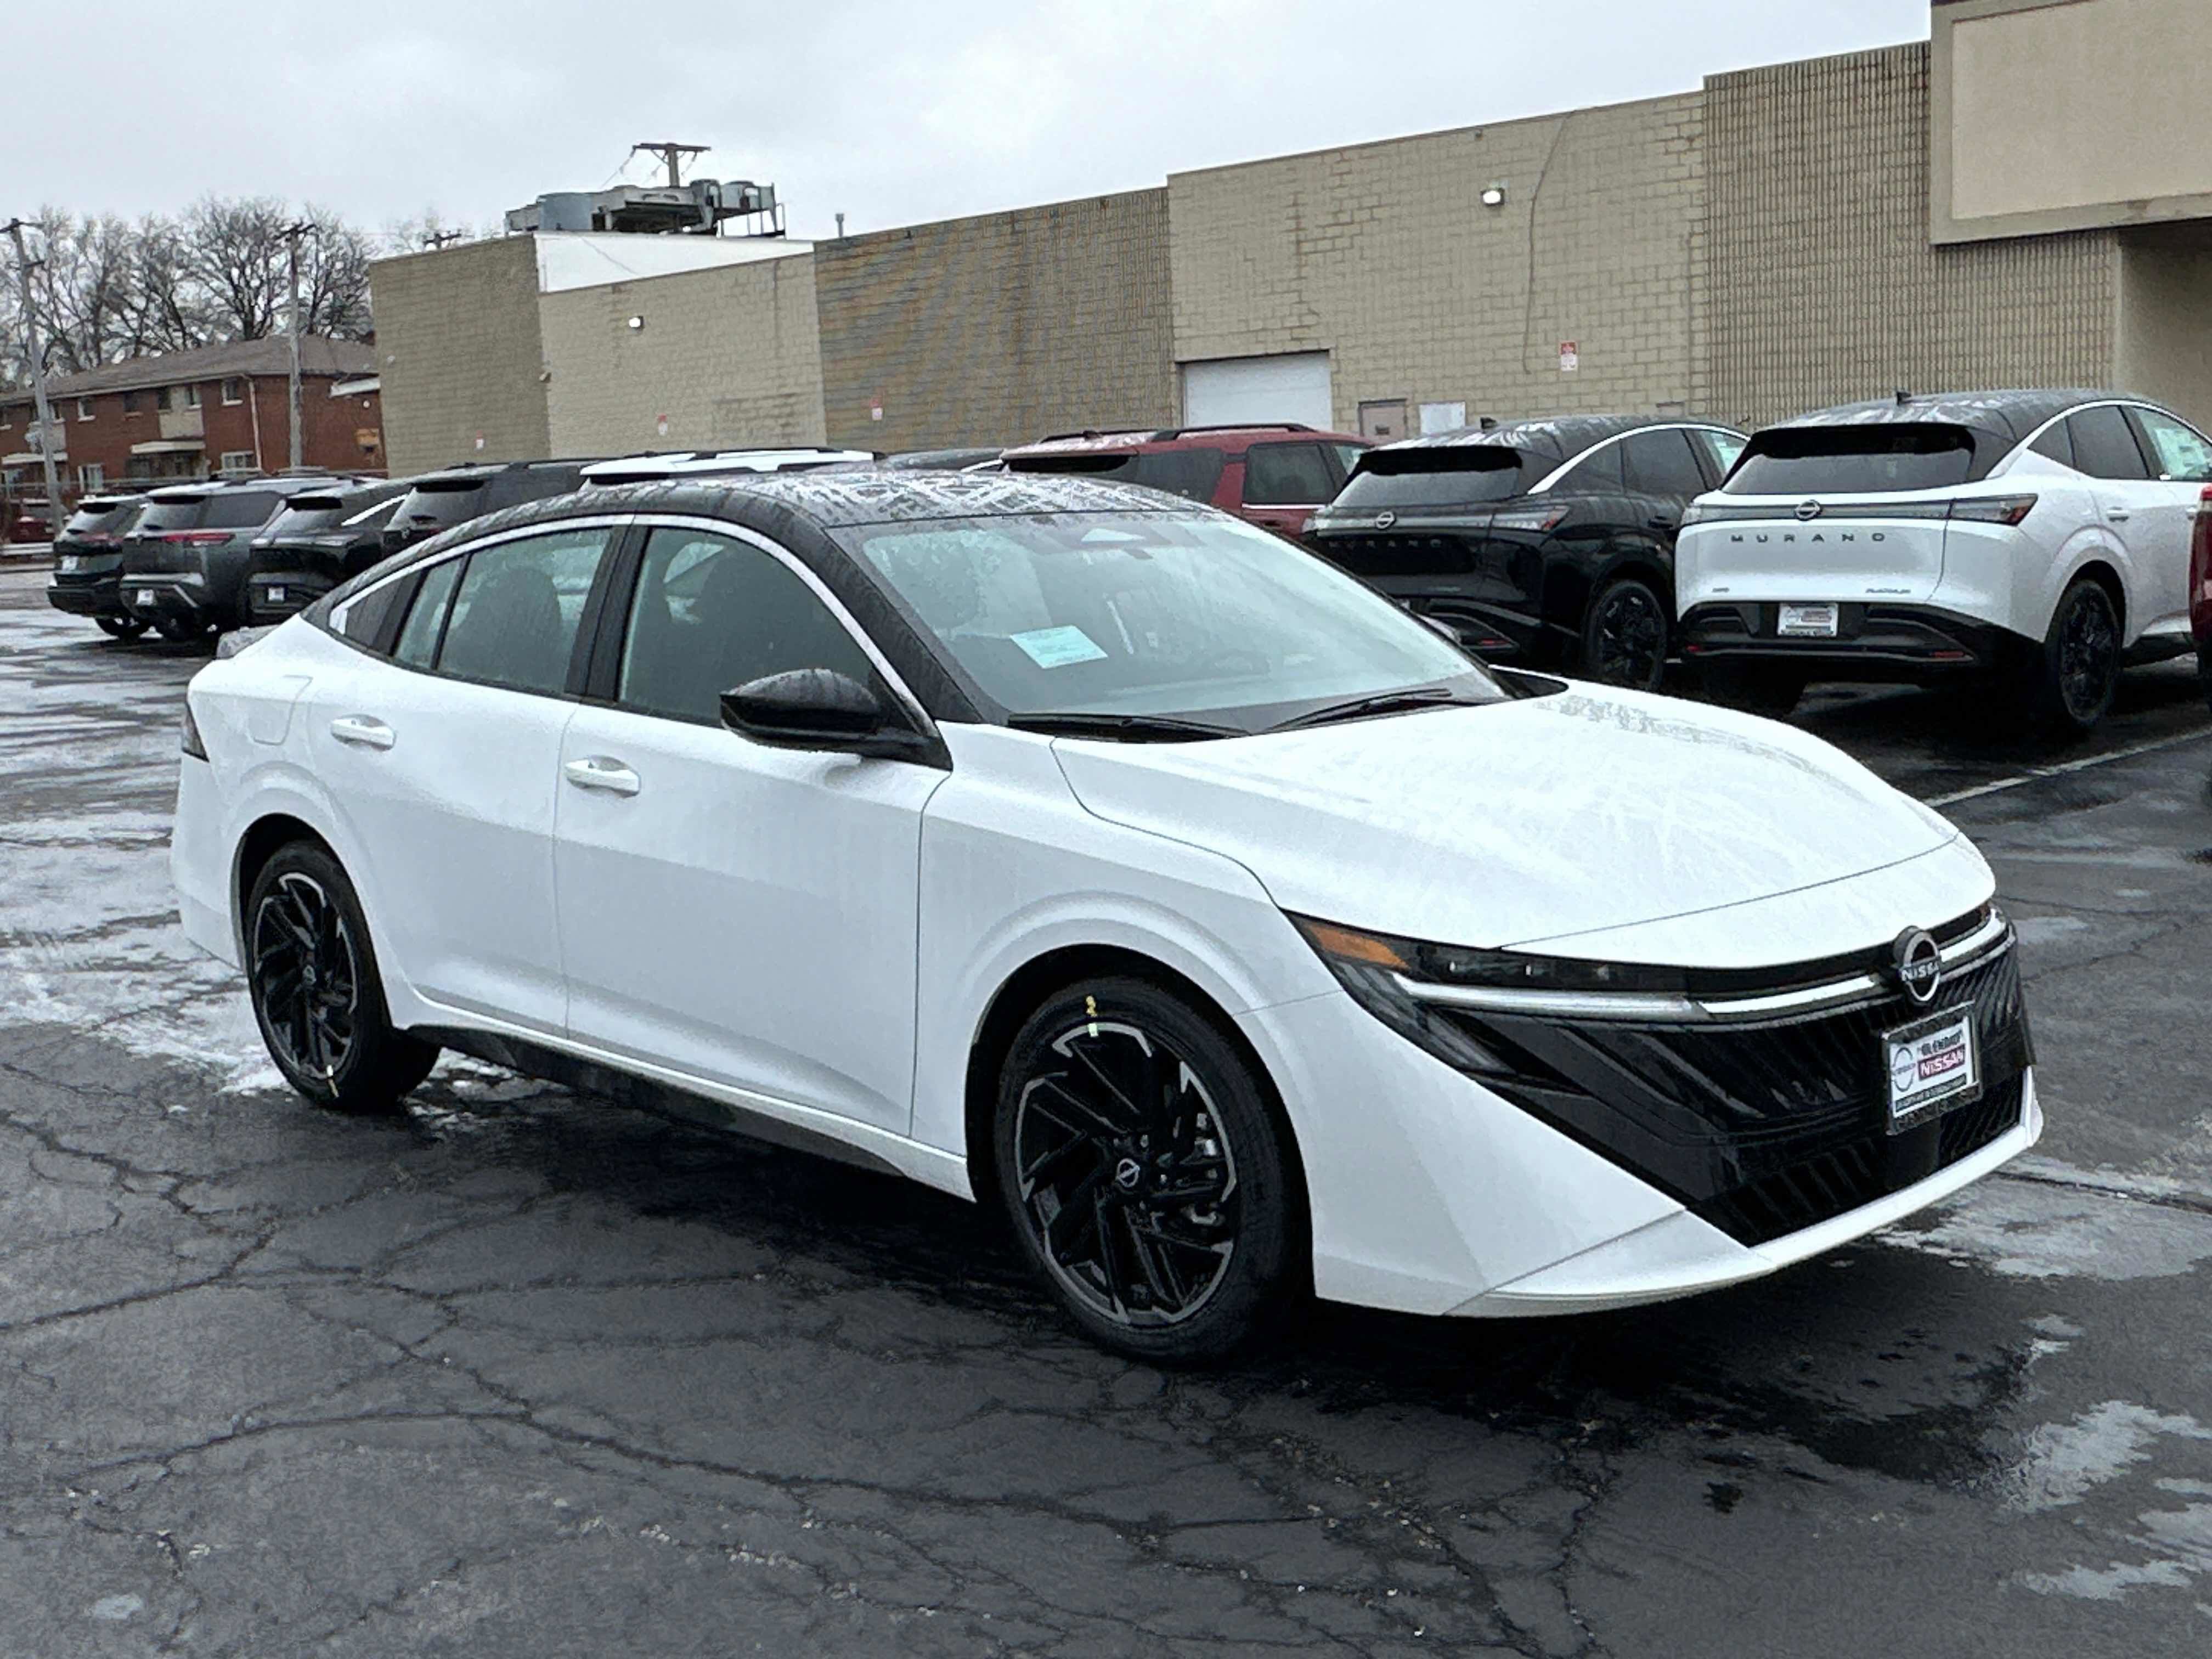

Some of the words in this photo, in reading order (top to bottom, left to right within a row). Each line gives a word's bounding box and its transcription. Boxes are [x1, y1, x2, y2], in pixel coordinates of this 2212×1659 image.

[1328, 538, 1442, 548] MRANO
[1730, 532, 1886, 543] MURANO
[1920, 1048, 1964, 1076] NISSAN
